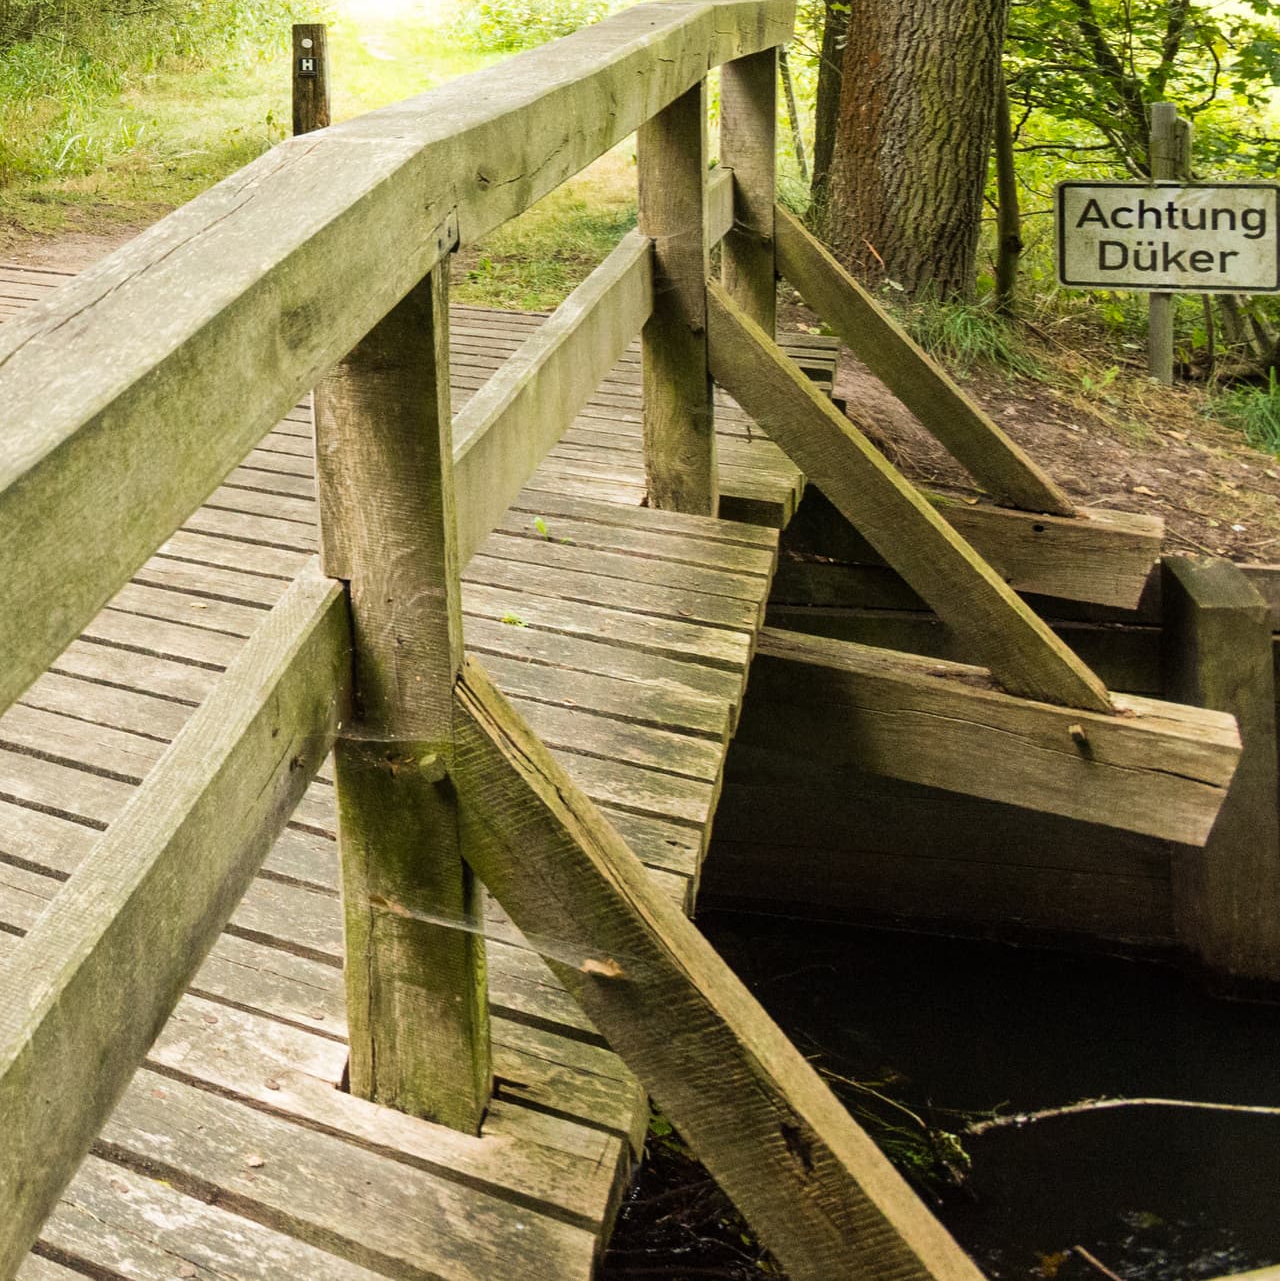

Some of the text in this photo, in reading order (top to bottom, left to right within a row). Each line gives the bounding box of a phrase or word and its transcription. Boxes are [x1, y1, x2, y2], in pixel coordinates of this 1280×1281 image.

[302, 59, 313, 70] H
[1076, 199, 1267, 240] Achtung
[1099, 240, 1240, 273] Düker
